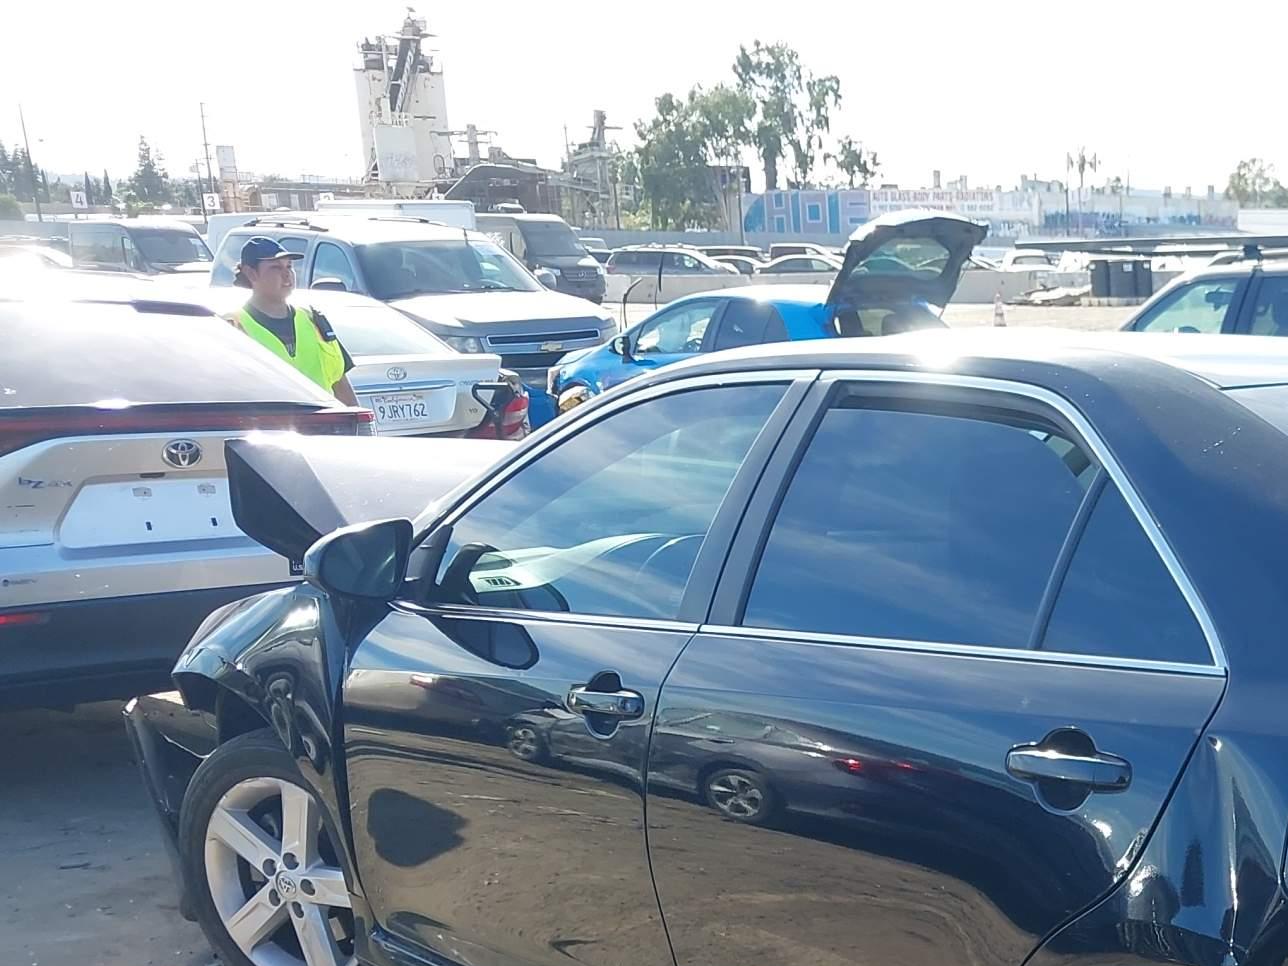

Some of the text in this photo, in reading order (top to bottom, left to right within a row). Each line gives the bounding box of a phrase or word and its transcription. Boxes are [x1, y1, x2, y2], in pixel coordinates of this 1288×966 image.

[75, 193, 84, 206] 4
[207, 196, 216, 208] 3
[378, 403, 428, 420] 9JRY762
